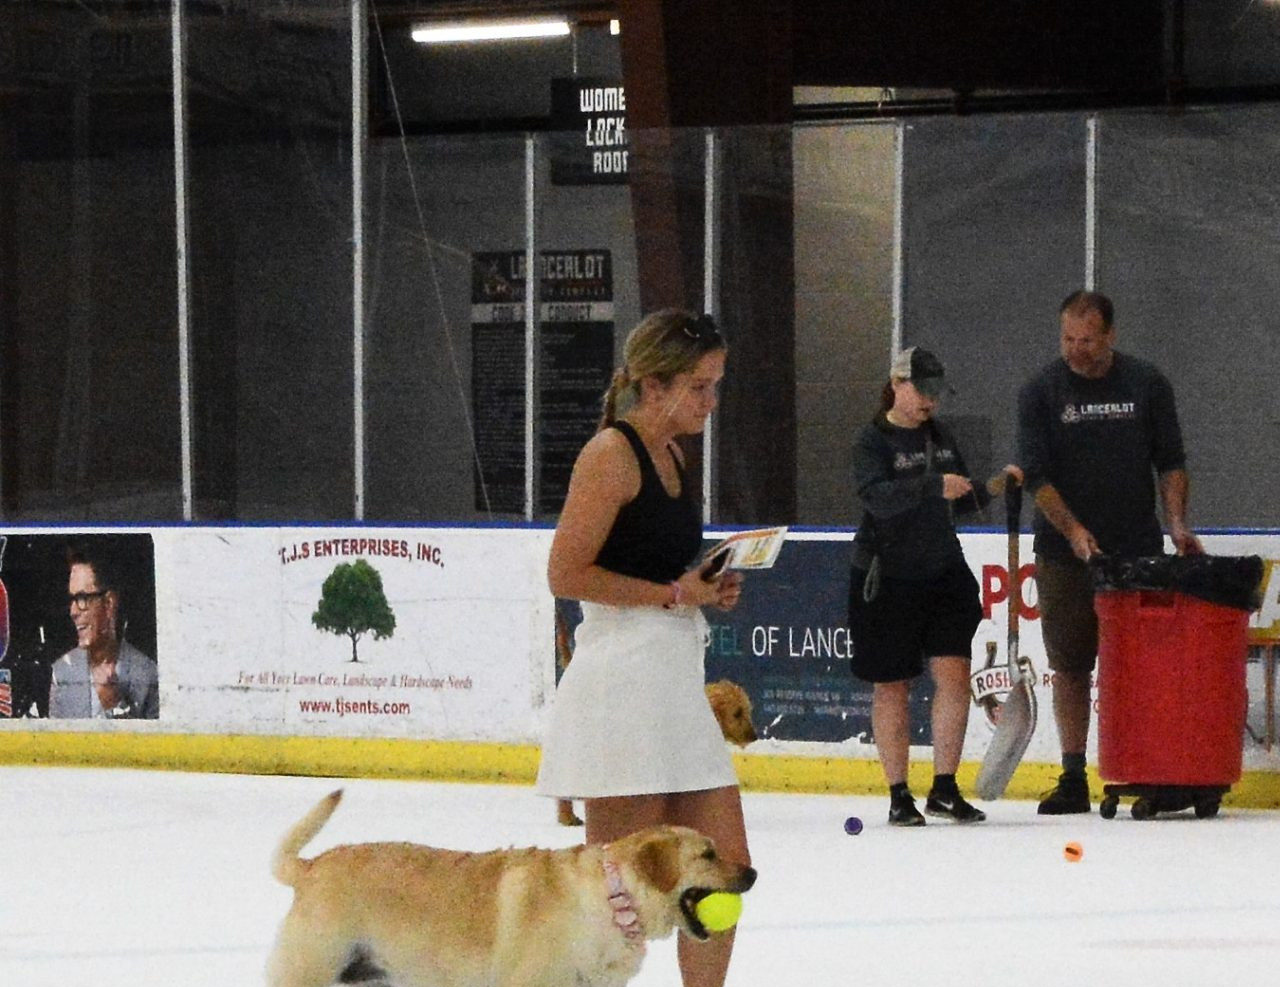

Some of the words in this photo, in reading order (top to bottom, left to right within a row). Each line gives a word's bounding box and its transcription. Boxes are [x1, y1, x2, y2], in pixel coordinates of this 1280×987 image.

[313, 538, 413, 562] ENTERPRISES,
[416, 542, 445, 568] INC.
[751, 625, 780, 657] OF
[299, 698, 411, 717] www.tjsents.com
